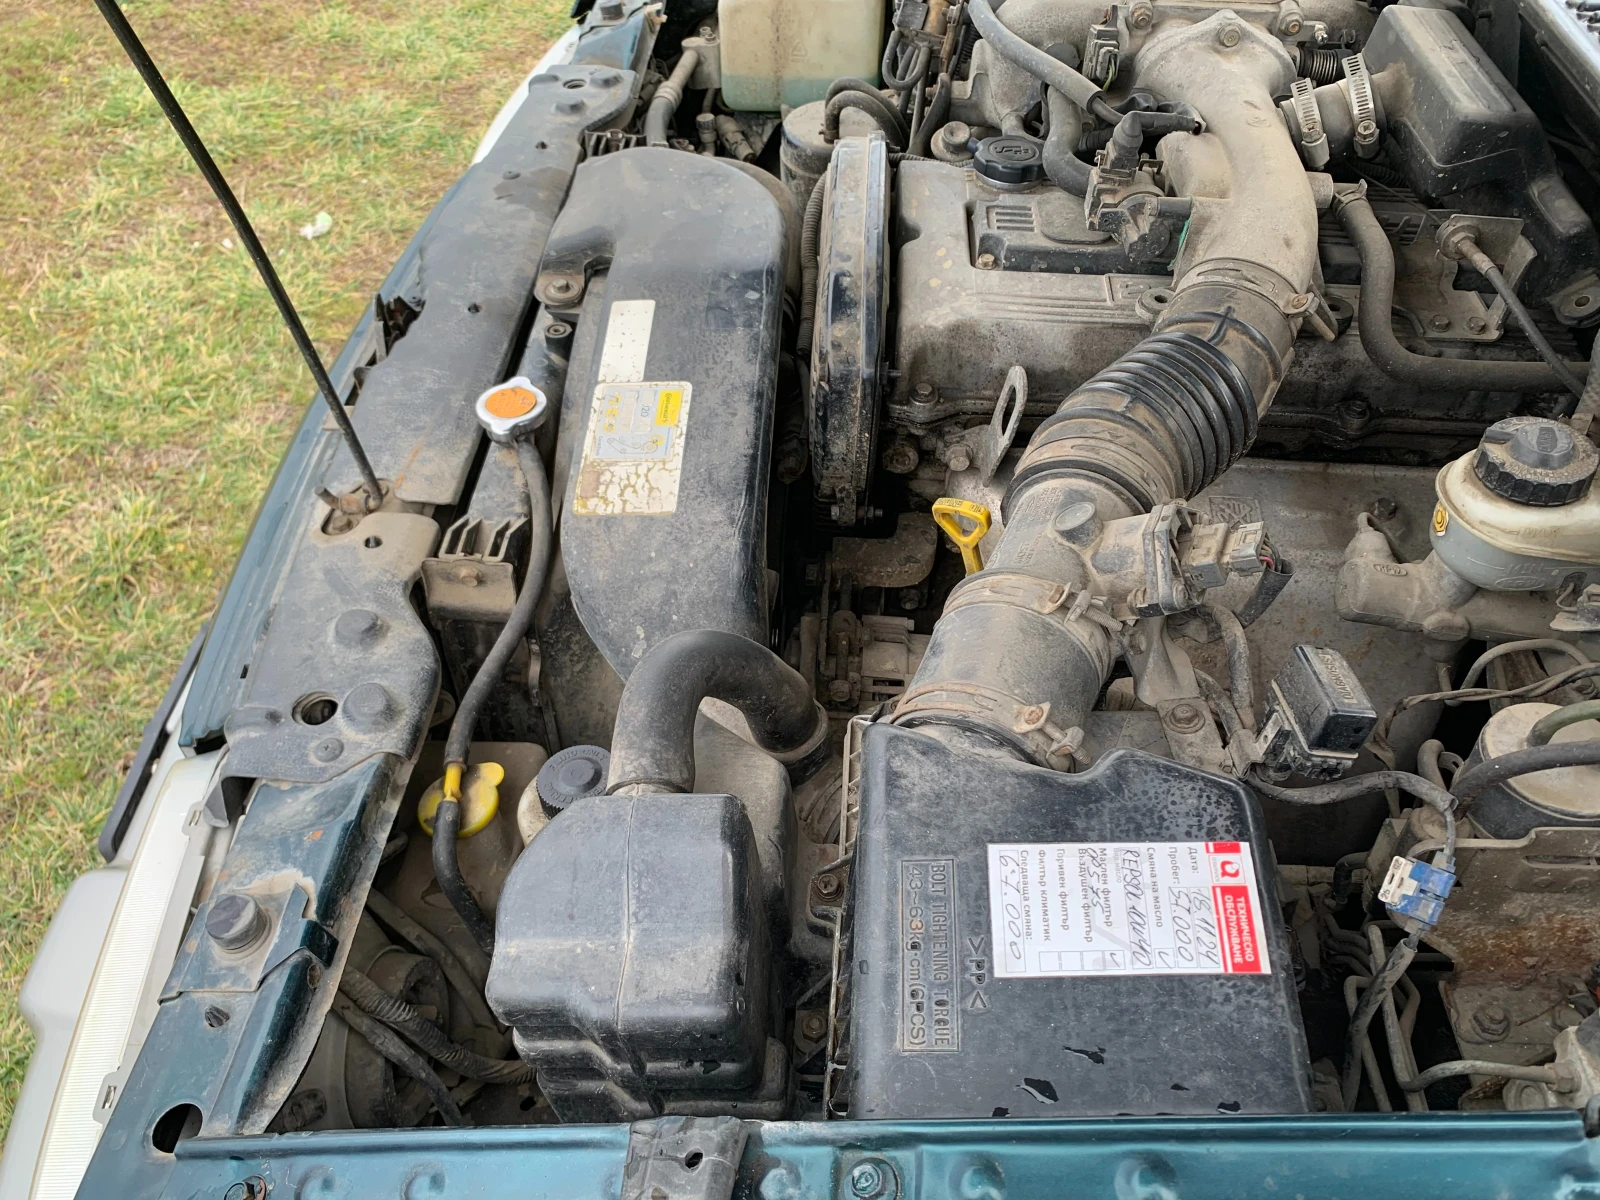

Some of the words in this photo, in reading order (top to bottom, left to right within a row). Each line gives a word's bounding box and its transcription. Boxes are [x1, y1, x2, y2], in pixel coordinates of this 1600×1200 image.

[1319, 655, 1355, 701] DIAGNOSIS
[582, 749, 608, 761] ONLY
[931, 864, 946, 895] BOLT
[1020, 850, 1030, 902] Следваща
[1038, 850, 1047, 887] Филтър
[1056, 848, 1067, 888] Горивен
[1078, 848, 1088, 899] Въздушен
[1098, 848, 1108, 885] Маслен
[1147, 847, 1158, 878] Смяна
[1168, 846, 1180, 885] Пробег:
[1188, 846, 1200, 874] Дата:
[1151, 881, 1159, 893] на
[1024, 904, 1033, 940] смяна:
[1041, 890, 1051, 941] климатик
[1059, 891, 1070, 931] филтър
[1082, 902, 1094, 943] филтър
[1102, 888, 1114, 927] филтър
[1153, 896, 1163, 928] масло
[932, 904, 949, 981] TIGHTENING
[1224, 895, 1243, 963] ОБСЛУЖВАНЕ
[1236, 896, 1255, 962] ТЕХНИЧЕСКО
[933, 990, 951, 1046] TORQUE
